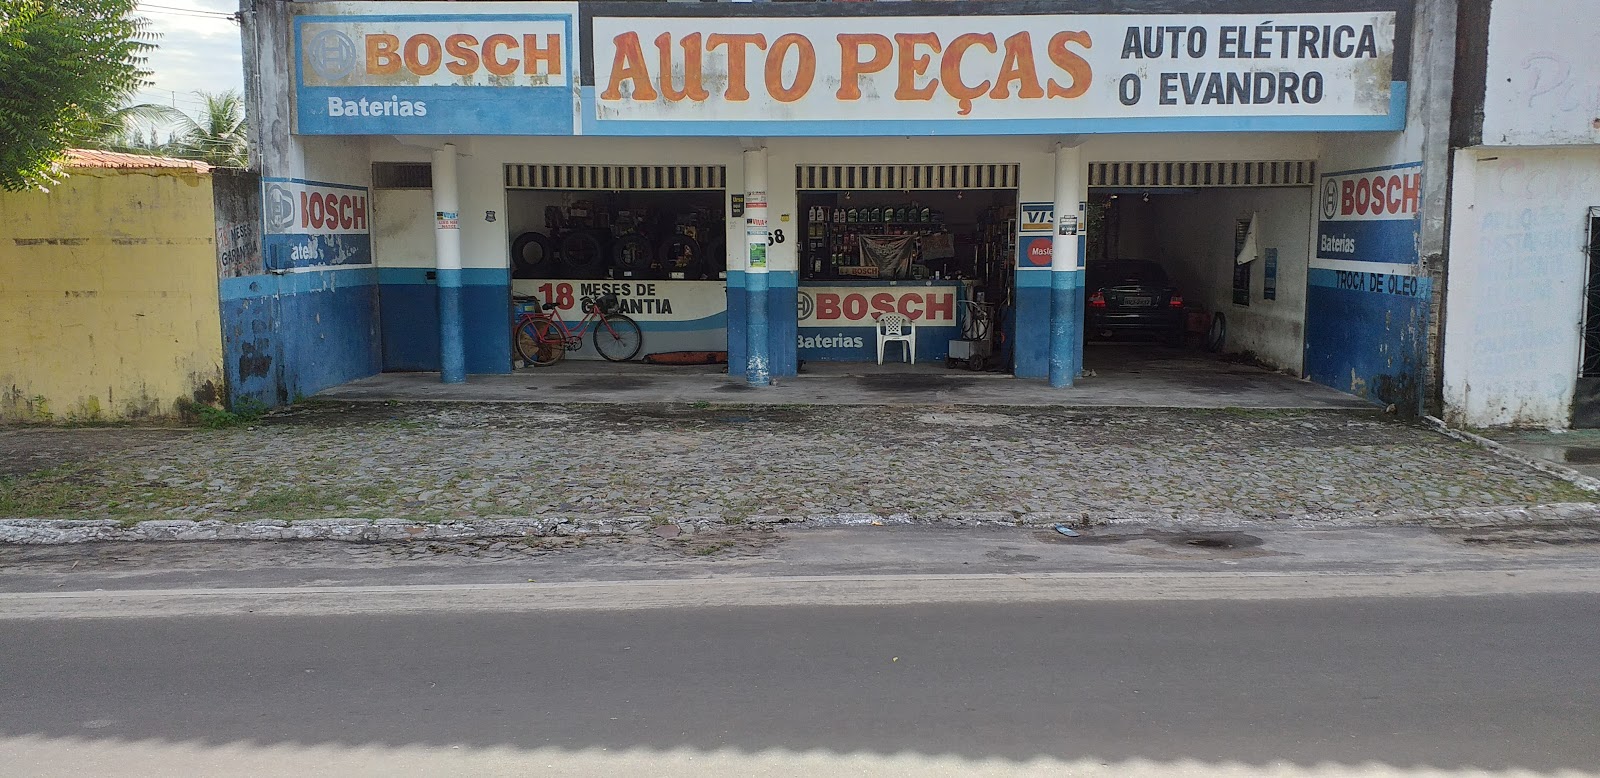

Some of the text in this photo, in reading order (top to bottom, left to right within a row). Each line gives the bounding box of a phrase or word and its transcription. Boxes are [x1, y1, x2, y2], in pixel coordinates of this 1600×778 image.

[1120, 20, 1378, 60] AUTO ELÉTRICA
[365, 33, 561, 76] BOSCH
[600, 30, 1093, 116] AUTO PEÇAS
[1118, 71, 1324, 106] O EVANDRO
[328, 95, 427, 118] Baterias
[1341, 173, 1421, 215] BOSCH
[230, 223, 252, 241] MESES
[1320, 233, 1355, 254] Baterias
[1031, 247, 1053, 256] Maste
[852, 267, 878, 275] BOSCH
[1336, 269, 1418, 297] TROCA DE ÓLEO
[538, 282, 656, 311] 18 MESES DE
[581, 298, 673, 314] GANTIA
[816, 292, 954, 321] BOSCH
[797, 332, 864, 349] Baterias
